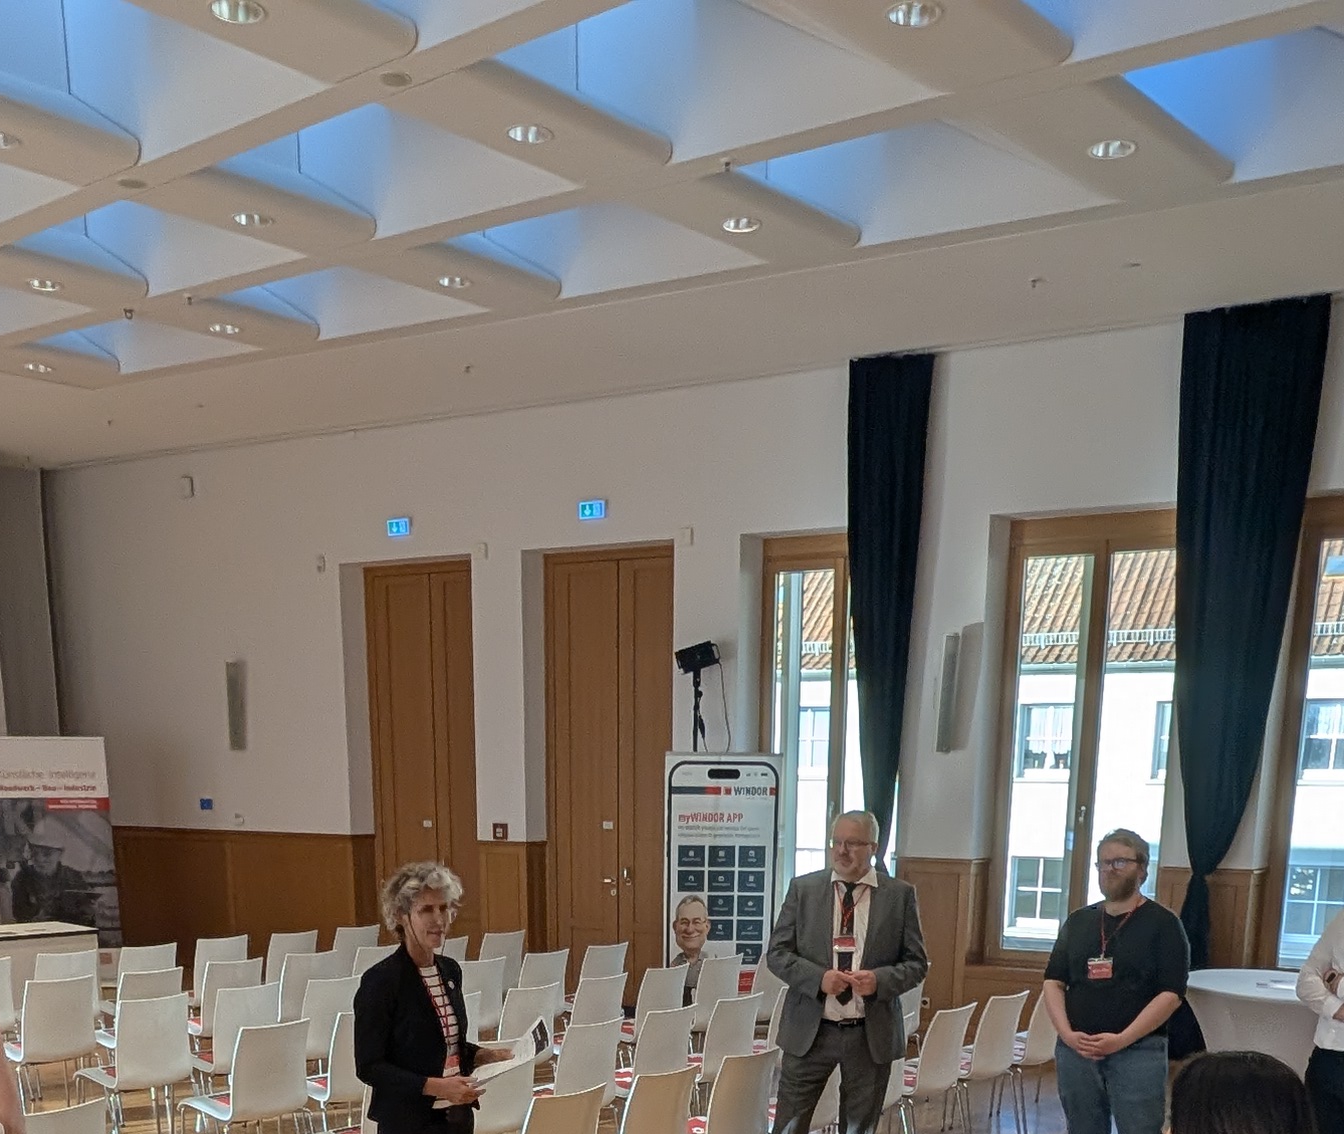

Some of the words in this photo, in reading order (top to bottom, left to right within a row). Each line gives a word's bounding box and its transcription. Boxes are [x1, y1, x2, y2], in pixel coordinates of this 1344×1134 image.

[733, 786, 768, 796] WINDOR
[678, 812, 725, 824] myWINDOR
[726, 812, 744, 823] APP
